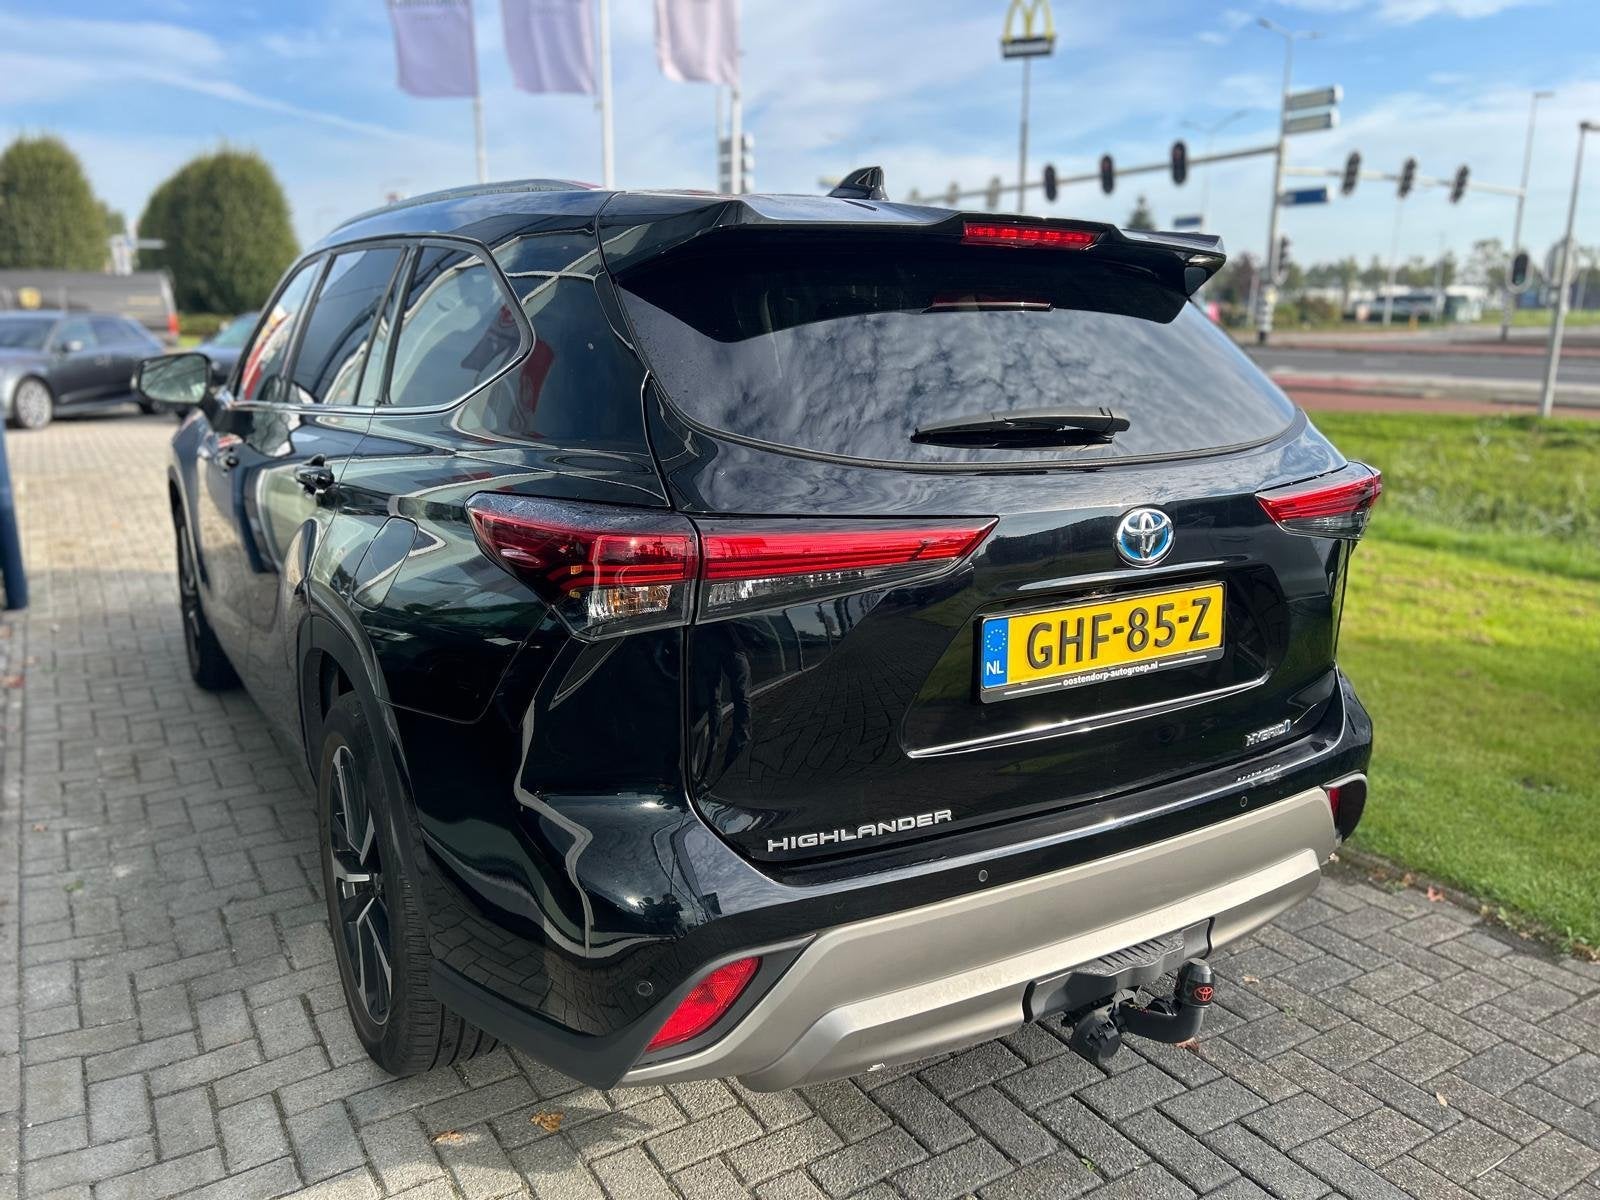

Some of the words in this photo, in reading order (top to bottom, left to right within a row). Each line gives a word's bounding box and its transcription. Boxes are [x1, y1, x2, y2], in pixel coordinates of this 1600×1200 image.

[1026, 596, 1212, 670] GHF-85-Z
[986, 660, 1005, 676] NL
[1063, 661, 1158, 686] oostendorp-autogroep.nl
[767, 809, 952, 852] HIGHLANDER
